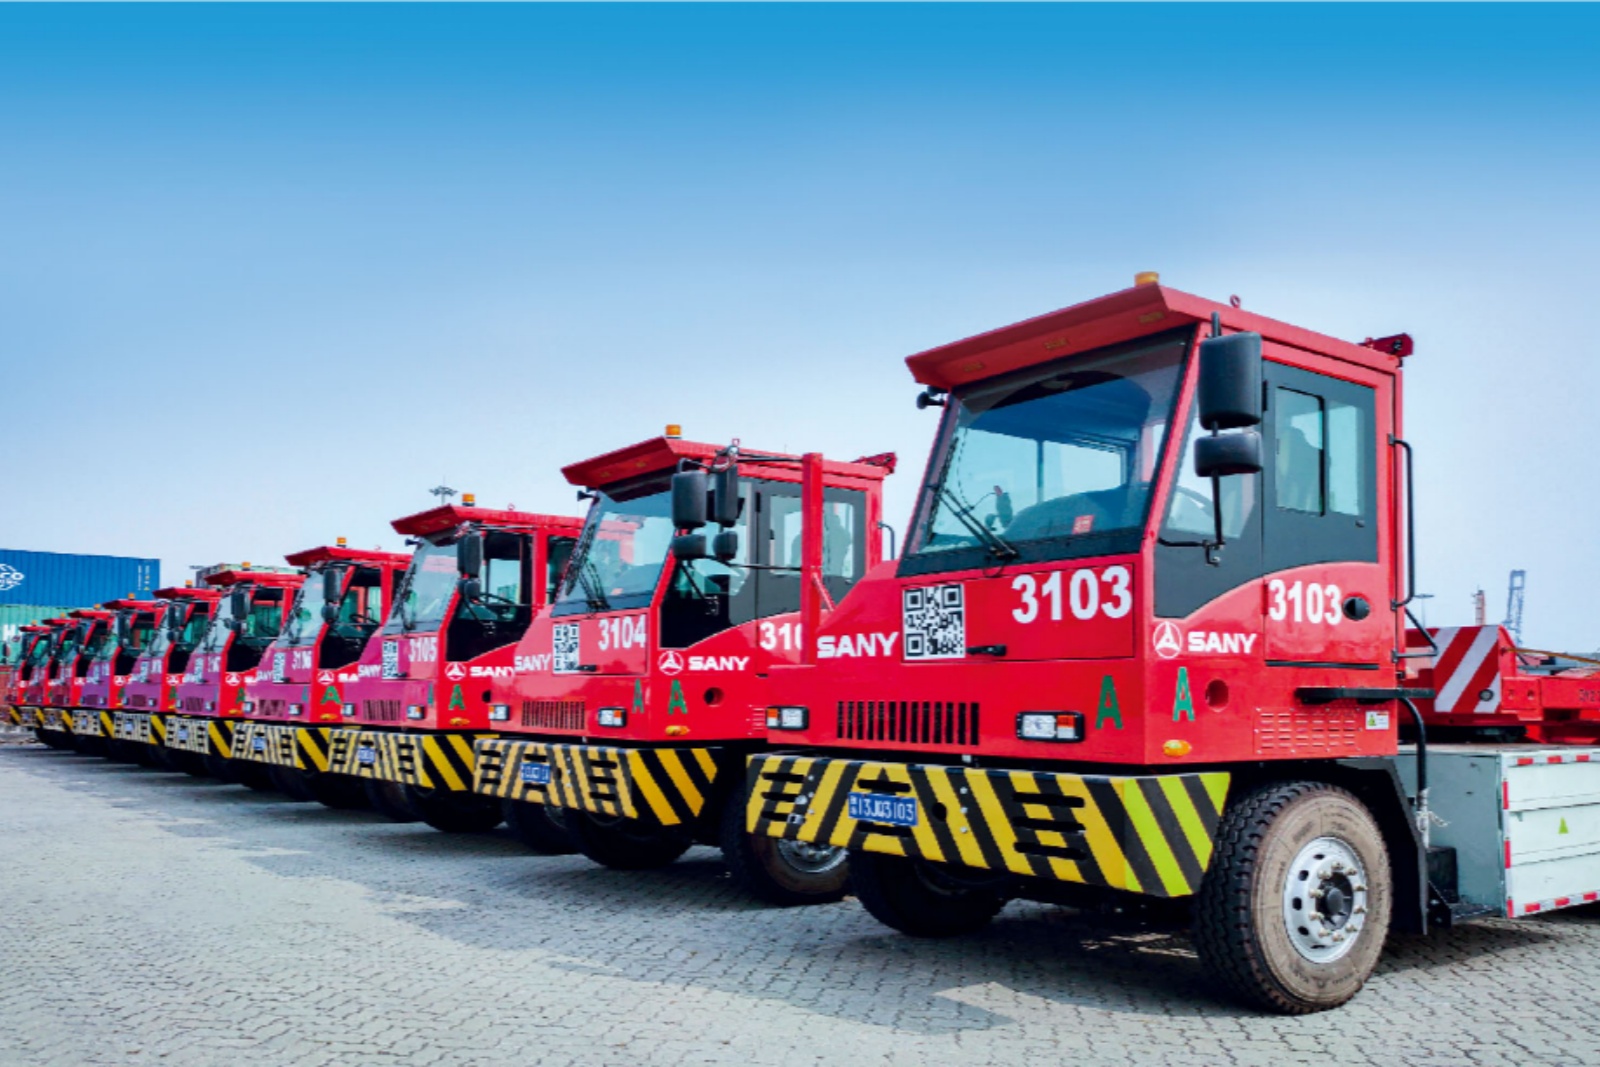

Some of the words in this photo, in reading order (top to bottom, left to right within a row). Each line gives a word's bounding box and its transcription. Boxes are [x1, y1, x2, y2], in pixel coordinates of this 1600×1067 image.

[1011, 565, 1132, 624] 3103
[1268, 579, 1342, 625] 3103
[598, 614, 646, 650] 3104
[817, 631, 899, 658] SANY
[1188, 631, 1257, 654] SANY
[408, 637, 438, 662] 3105
[514, 654, 552, 672] SANY
[687, 656, 750, 671] SANY
[320, 685, 343, 705] A
[449, 684, 465, 711] A
[632, 678, 645, 714] A
[668, 679, 688, 714] A
[1095, 675, 1124, 729] A
[1172, 667, 1195, 721] A
